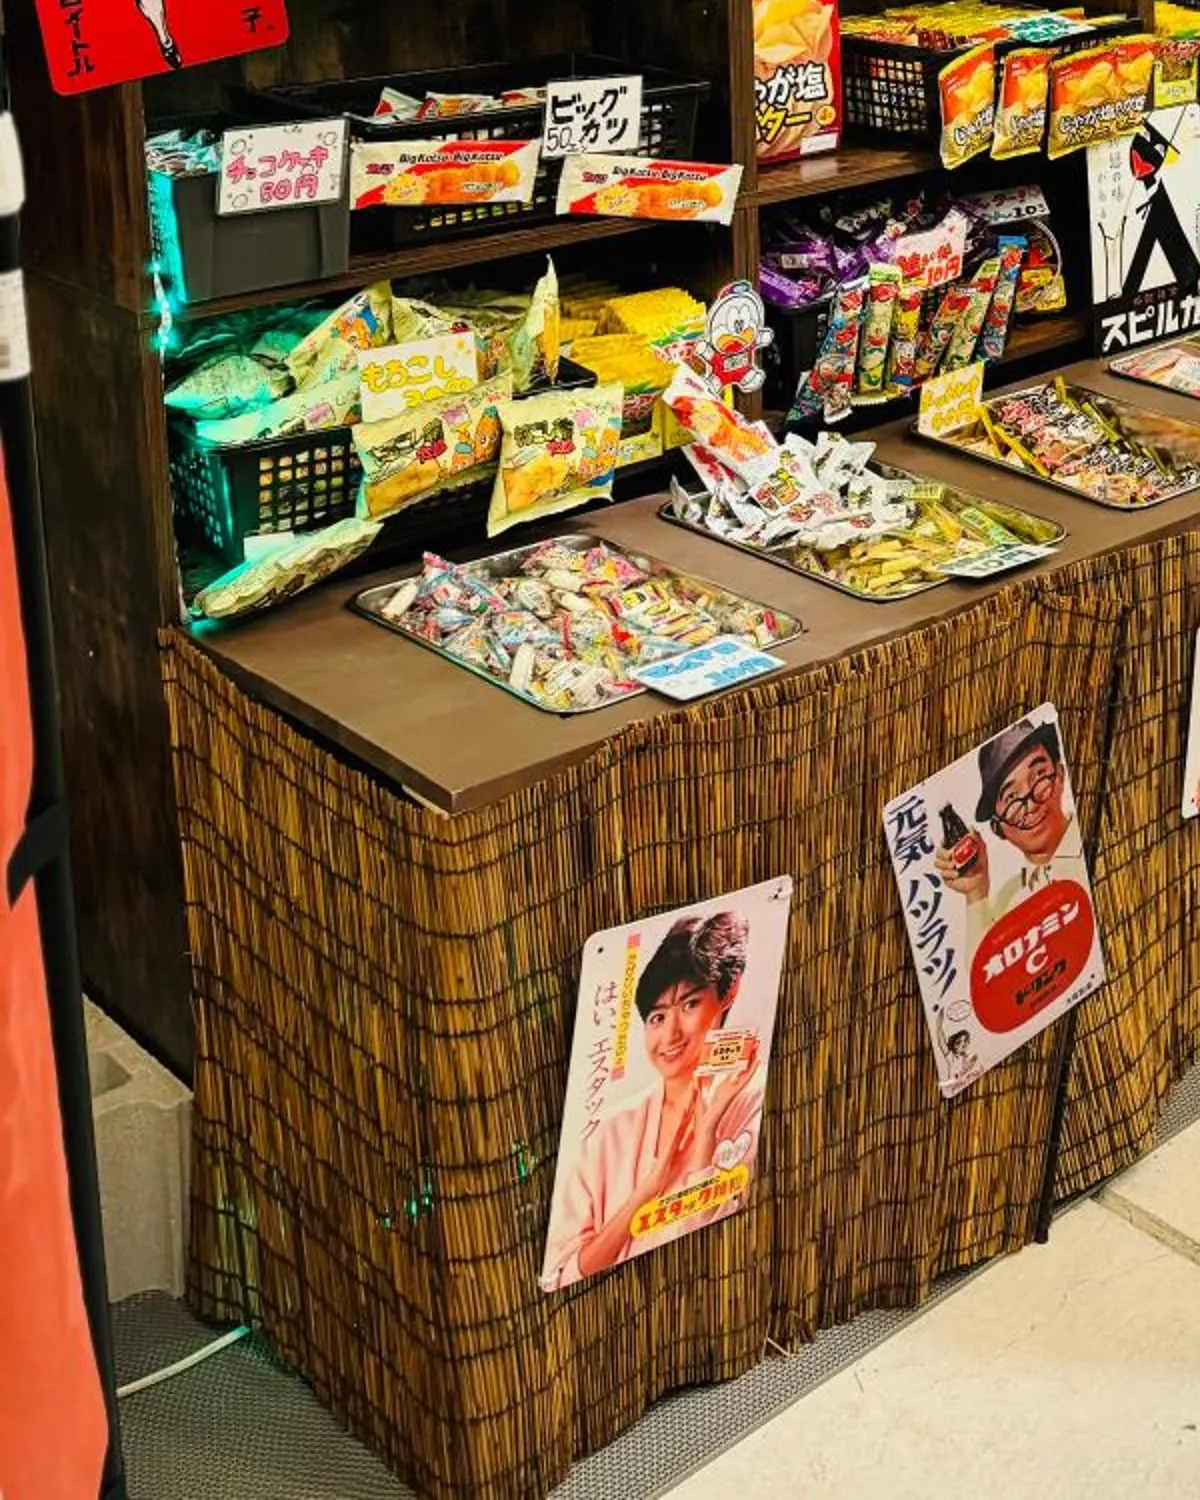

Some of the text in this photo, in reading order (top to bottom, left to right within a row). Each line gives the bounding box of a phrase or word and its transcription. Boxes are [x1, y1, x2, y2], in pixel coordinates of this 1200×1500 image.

[551, 86, 628, 125] ビッグ
[582, 116, 629, 146] カツ
[361, 356, 456, 393] もろこし
[887, 795, 935, 875] 元気
[983, 900, 1080, 985] オロナミン
[1025, 943, 1049, 975] C
[579, 1037, 612, 1142] エスタック
